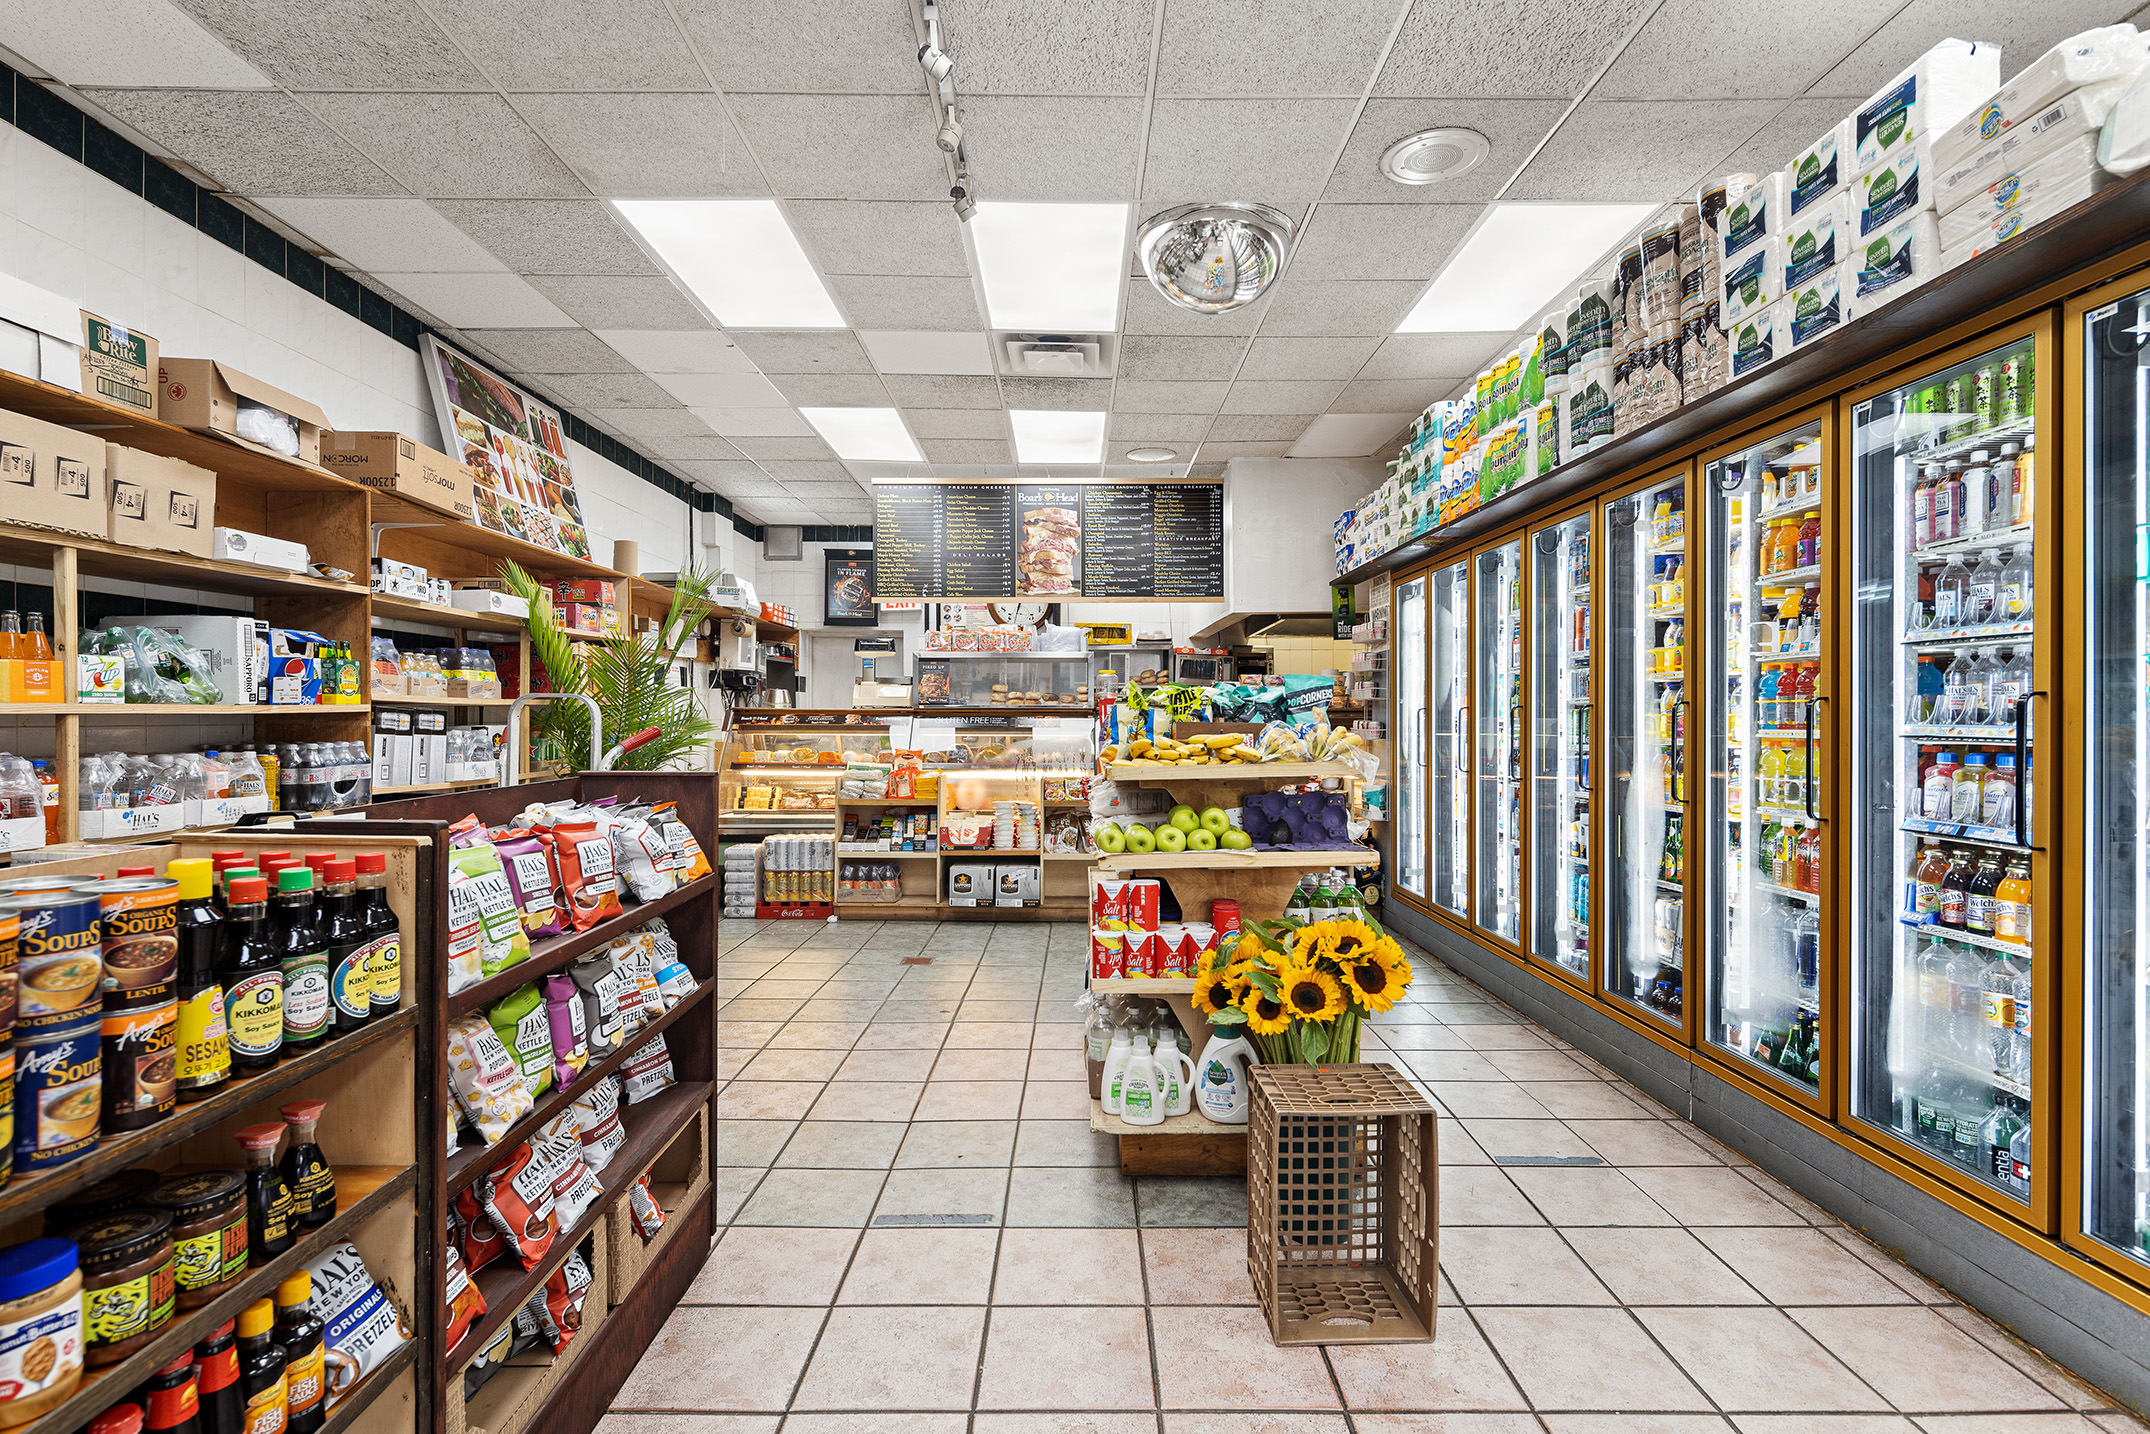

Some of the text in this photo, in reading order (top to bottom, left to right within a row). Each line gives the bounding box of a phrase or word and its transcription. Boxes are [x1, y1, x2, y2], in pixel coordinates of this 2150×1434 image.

[1870, 178, 1896, 197] seventh
[110, 342, 137, 362] Rite
[158, 367, 168, 384] UP
[323, 454, 368, 464] MORCON
[360, 476, 396, 487] 12300R
[1018, 492, 1079, 502] Boar's Head
[245, 657, 253, 693] SAPPORO
[300, 696, 311, 705] 36
[1287, 688, 1333, 708] POPCORNERS
[970, 716, 990, 724] FREE
[133, 812, 160, 826] HAL'S
[583, 843, 609, 859] HAL'S
[519, 857, 546, 874] HAL'S
[129, 909, 166, 919] ORGANIC
[483, 903, 505, 915] KETTLE
[1103, 903, 1120, 915] Salt
[109, 905, 177, 936] SOUPS
[25, 920, 101, 955] SOUPS
[1109, 954, 1123, 965] Salt
[1127, 954, 1144, 967] Salt
[1165, 954, 1182, 967] Salt
[126, 985, 167, 1000] LENTIL
[291, 985, 325, 997] KIKKOMAN
[287, 1000, 303, 1009] Less
[306, 1002, 327, 1013] Sauce
[33, 1009, 83, 1027] CHICKEN
[116, 1012, 167, 1052] Amy's
[244, 1020, 280, 1033] Soy Sauce
[477, 1033, 501, 1056] HAL'S
[517, 1038, 542, 1051] KETTLE
[648, 1040, 664, 1050] YORK
[14, 1041, 77, 1082] Amy's
[630, 1059, 658, 1074] CINNAMON
[486, 1072, 505, 1084] KETTLE
[641, 1066, 669, 1086] PRETZELS
[588, 1081, 612, 1110] HAL'S
[538, 1131, 575, 1162] HAL'S
[551, 1155, 567, 1169] NEW
[1998, 1149, 2009, 1184] entia
[523, 1175, 539, 1189] NEW
[570, 1174, 595, 1204] PRETZELS
[294, 1191, 313, 1200] Soy
[524, 1181, 546, 1200] KETTLE
[268, 1213, 287, 1225] Soy
[310, 1268, 367, 1316] NEW YOR
[330, 1288, 383, 1337] ORIGINALS
[344, 1306, 398, 1356] PRETZELS
[290, 1375, 317, 1395] FISH
[254, 1406, 284, 1428] FISH
